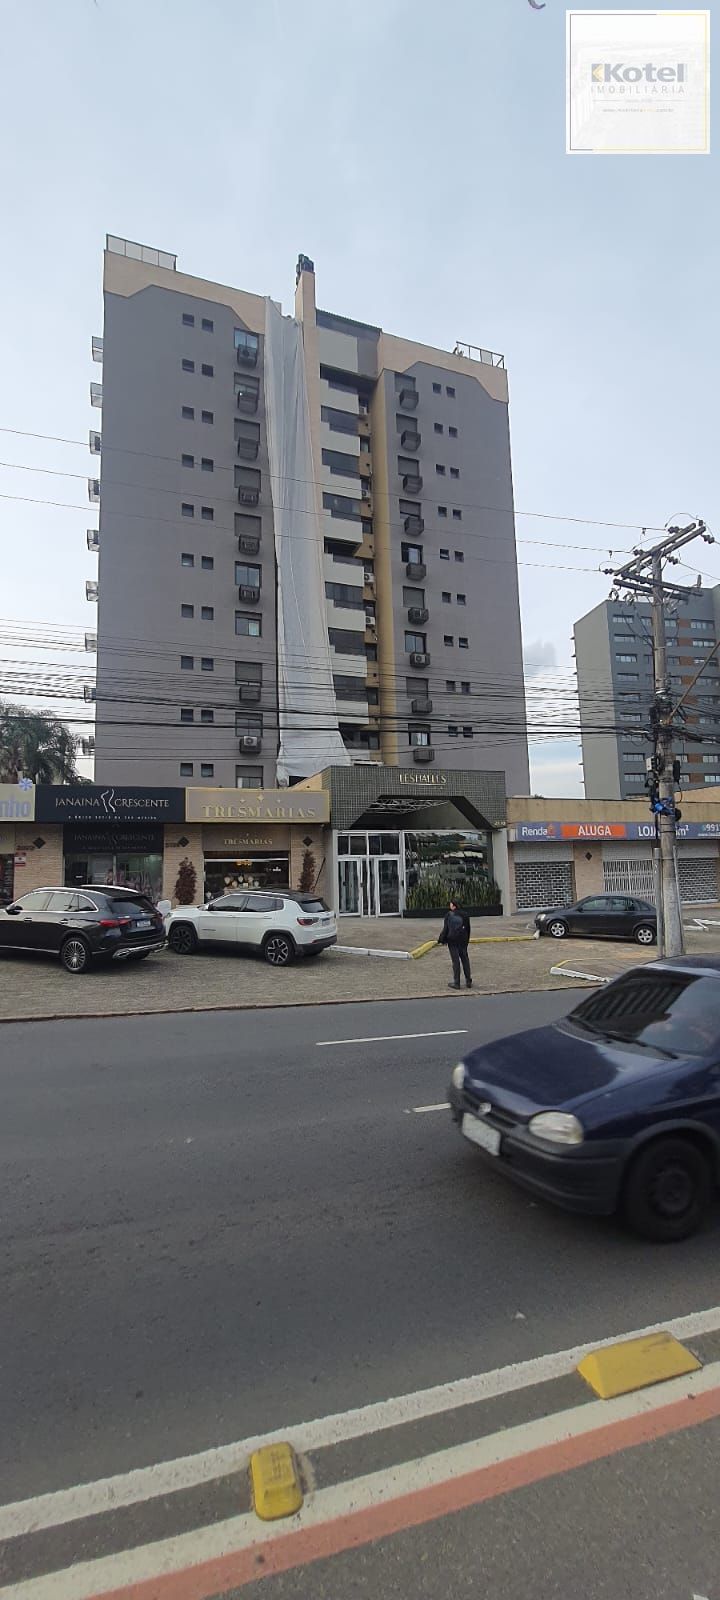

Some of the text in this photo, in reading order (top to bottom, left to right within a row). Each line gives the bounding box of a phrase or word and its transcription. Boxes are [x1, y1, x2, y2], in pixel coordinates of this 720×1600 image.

[55, 797, 170, 808] JANAINA CRESCENTE
[522, 826, 548, 836] Renda
[578, 825, 612, 836] ALUGA
[706, 823, 720, 832] 991
